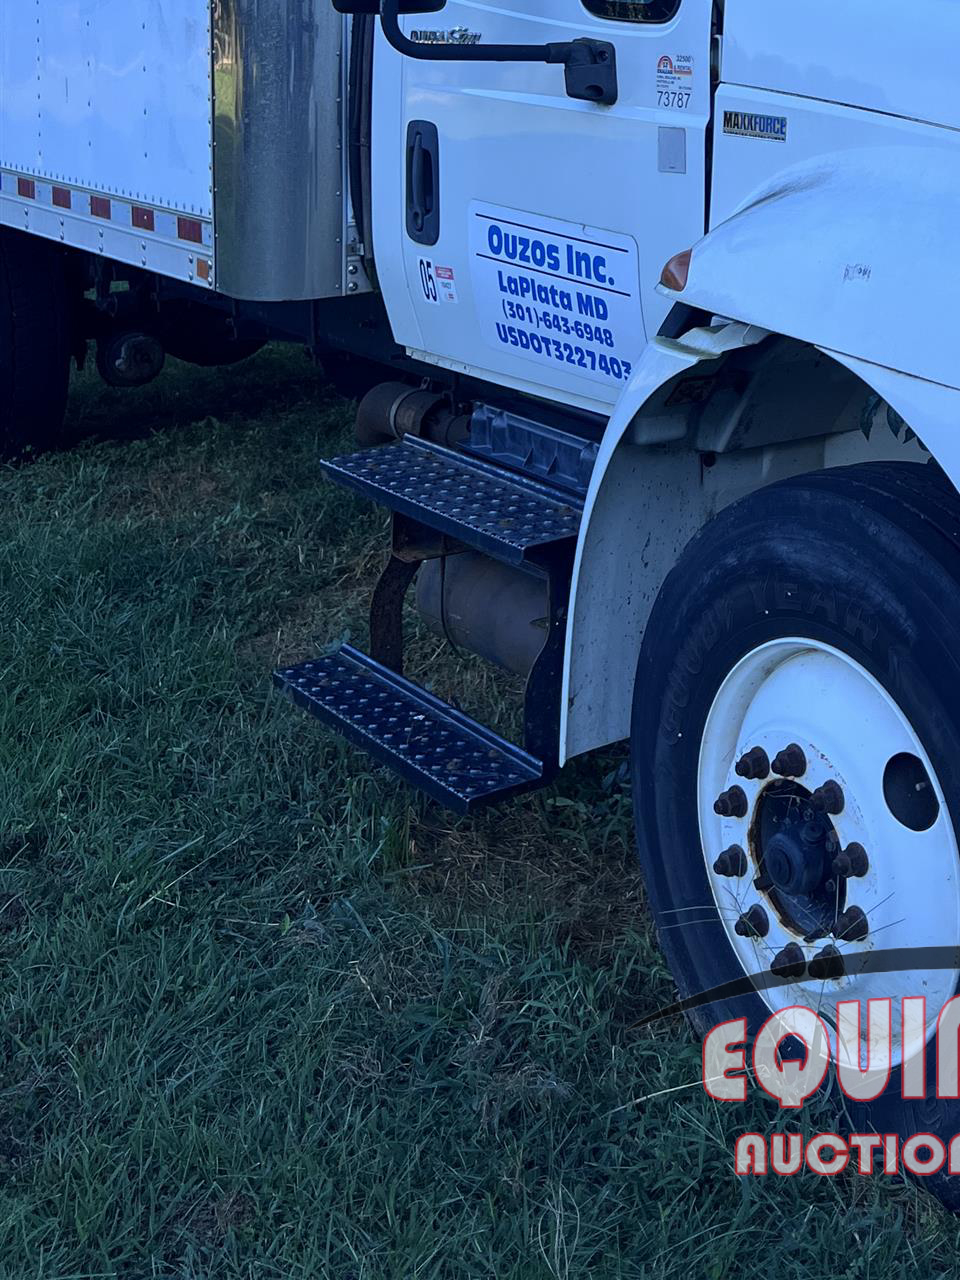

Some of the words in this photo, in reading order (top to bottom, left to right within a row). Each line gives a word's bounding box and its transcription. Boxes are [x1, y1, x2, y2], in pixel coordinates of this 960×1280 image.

[657, 90, 691, 109] 73787
[723, 110, 787, 135] MAXXFORCE
[488, 224, 560, 272] Ouzos
[566, 244, 615, 286] Inc.
[419, 258, 437, 302] 05
[497, 270, 573, 312] LaPlata
[577, 292, 609, 321] MD
[502, 299, 615, 348] (301)-643-6948
